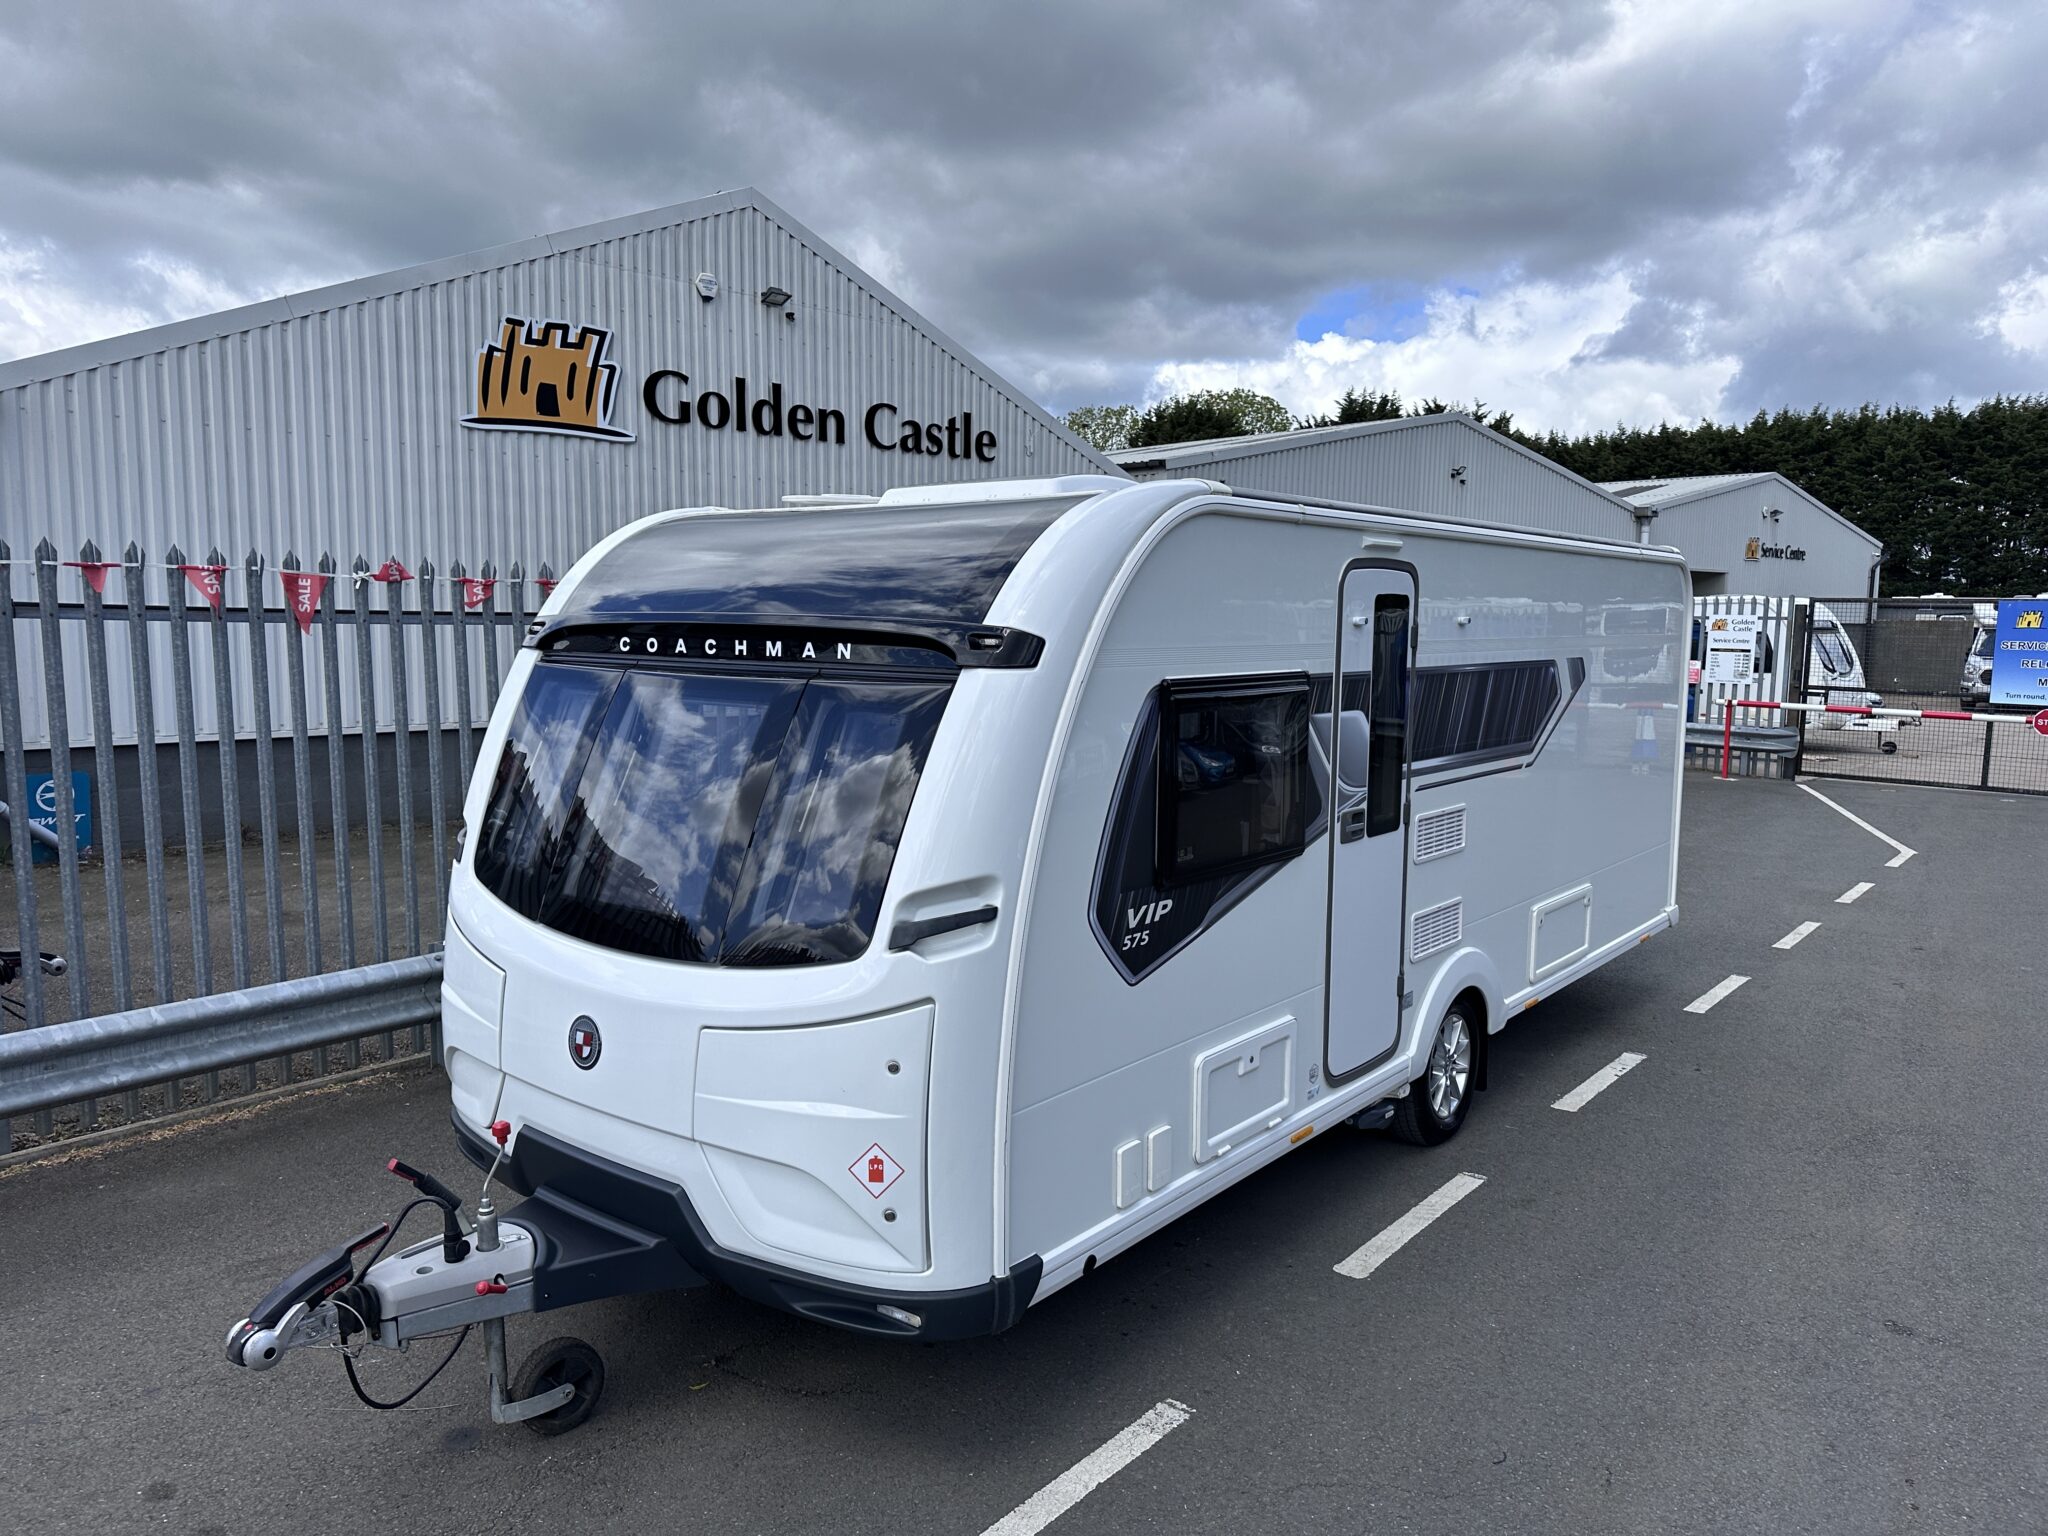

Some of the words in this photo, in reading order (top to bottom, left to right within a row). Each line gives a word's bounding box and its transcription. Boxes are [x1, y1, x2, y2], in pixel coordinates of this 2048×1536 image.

[643, 369, 846, 445] Golden
[864, 402, 998, 463] Castle
[1760, 542, 1784, 559] Service
[1785, 544, 1807, 561] Centre
[298, 577, 312, 613] SALE
[1731, 618, 1756, 626] Golden
[1732, 625, 1753, 633] Castle
[619, 636, 852, 660] COACHMAN
[2001, 641, 2048, 651] SERVIC
[2020, 659, 2048, 669] REL
[2023, 693, 2047, 701] round,
[1127, 899, 1173, 929] VIP
[1122, 930, 1150, 951] 575
[869, 1163, 883, 1171] LPG
